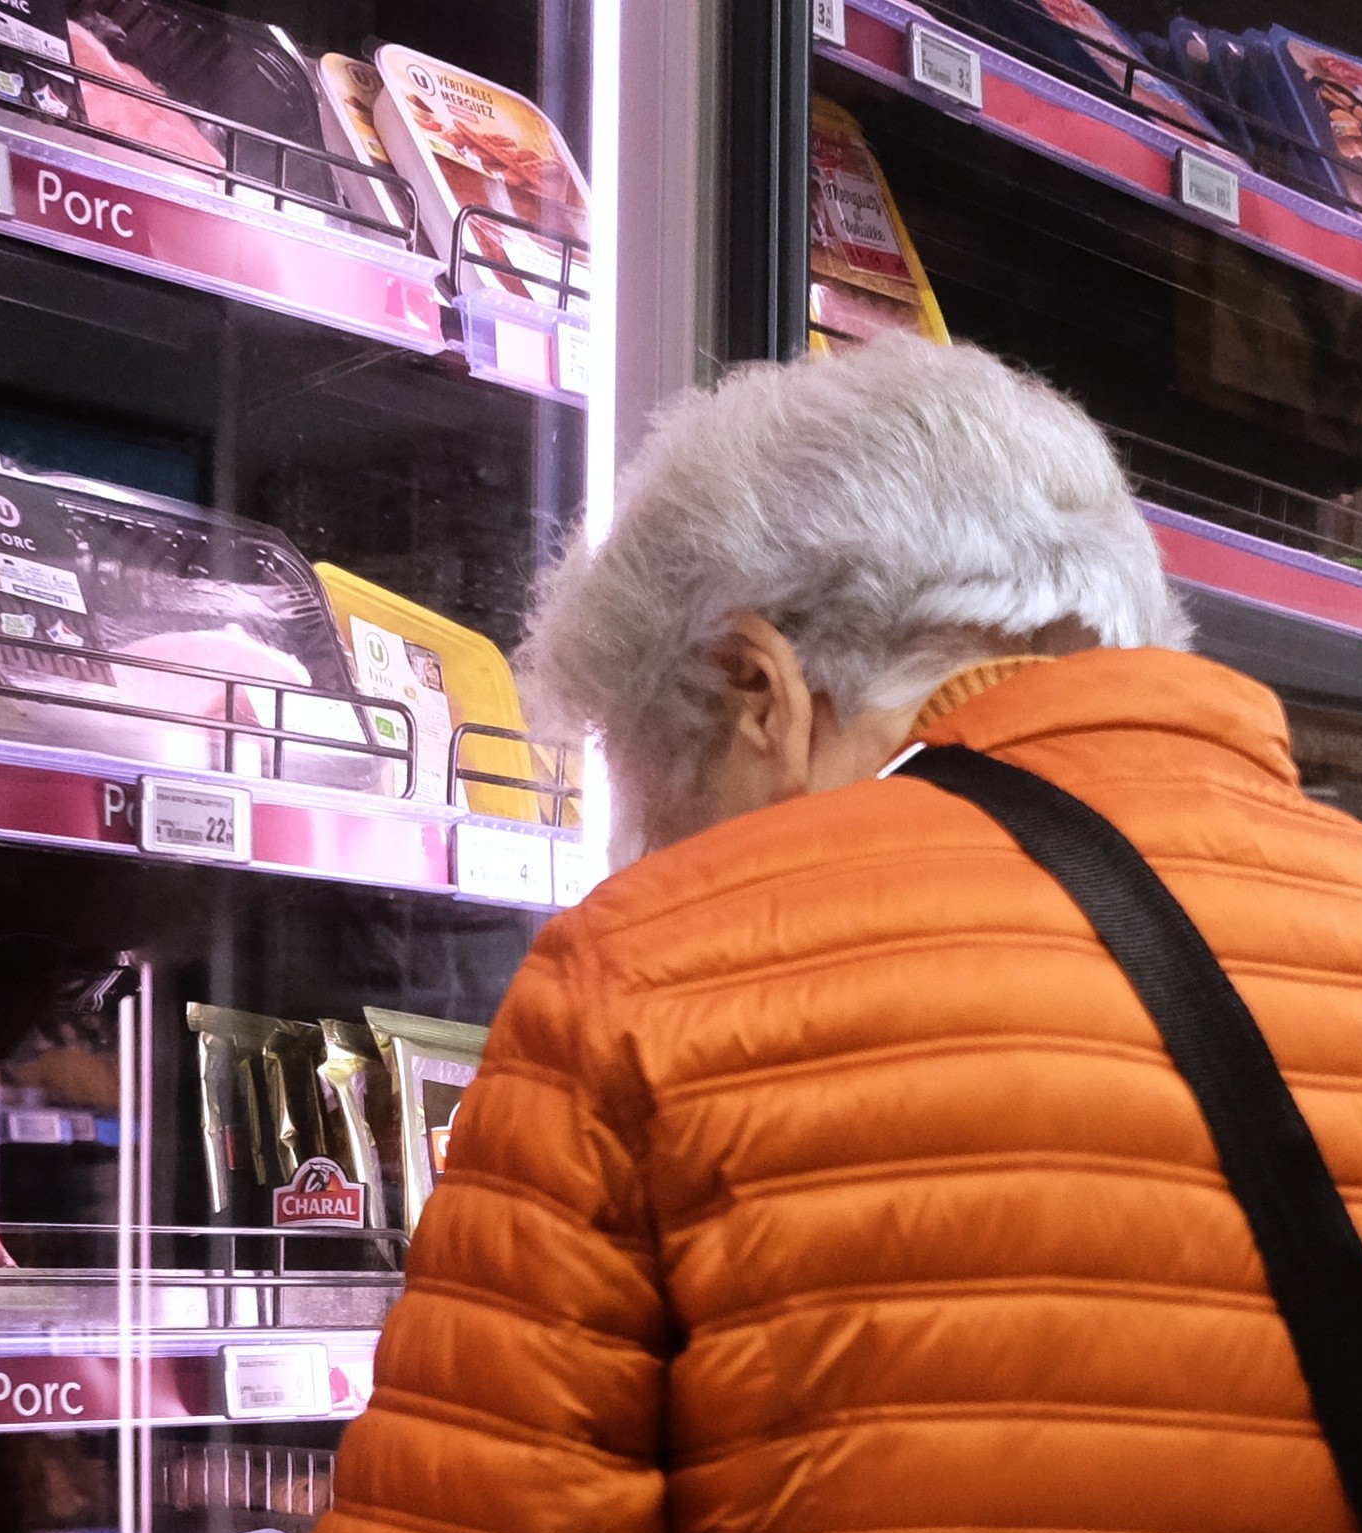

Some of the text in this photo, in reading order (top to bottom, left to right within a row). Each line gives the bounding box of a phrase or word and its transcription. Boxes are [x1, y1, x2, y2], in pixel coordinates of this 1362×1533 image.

[437, 74, 494, 105] VÉRITABLES
[441, 90, 495, 120] MERGUEZ
[38, 169, 135, 239] Porc
[368, 666, 394, 689] bio
[205, 816, 227, 844] 22
[519, 862, 528, 886] 4
[281, 1195, 357, 1217] CHARAL
